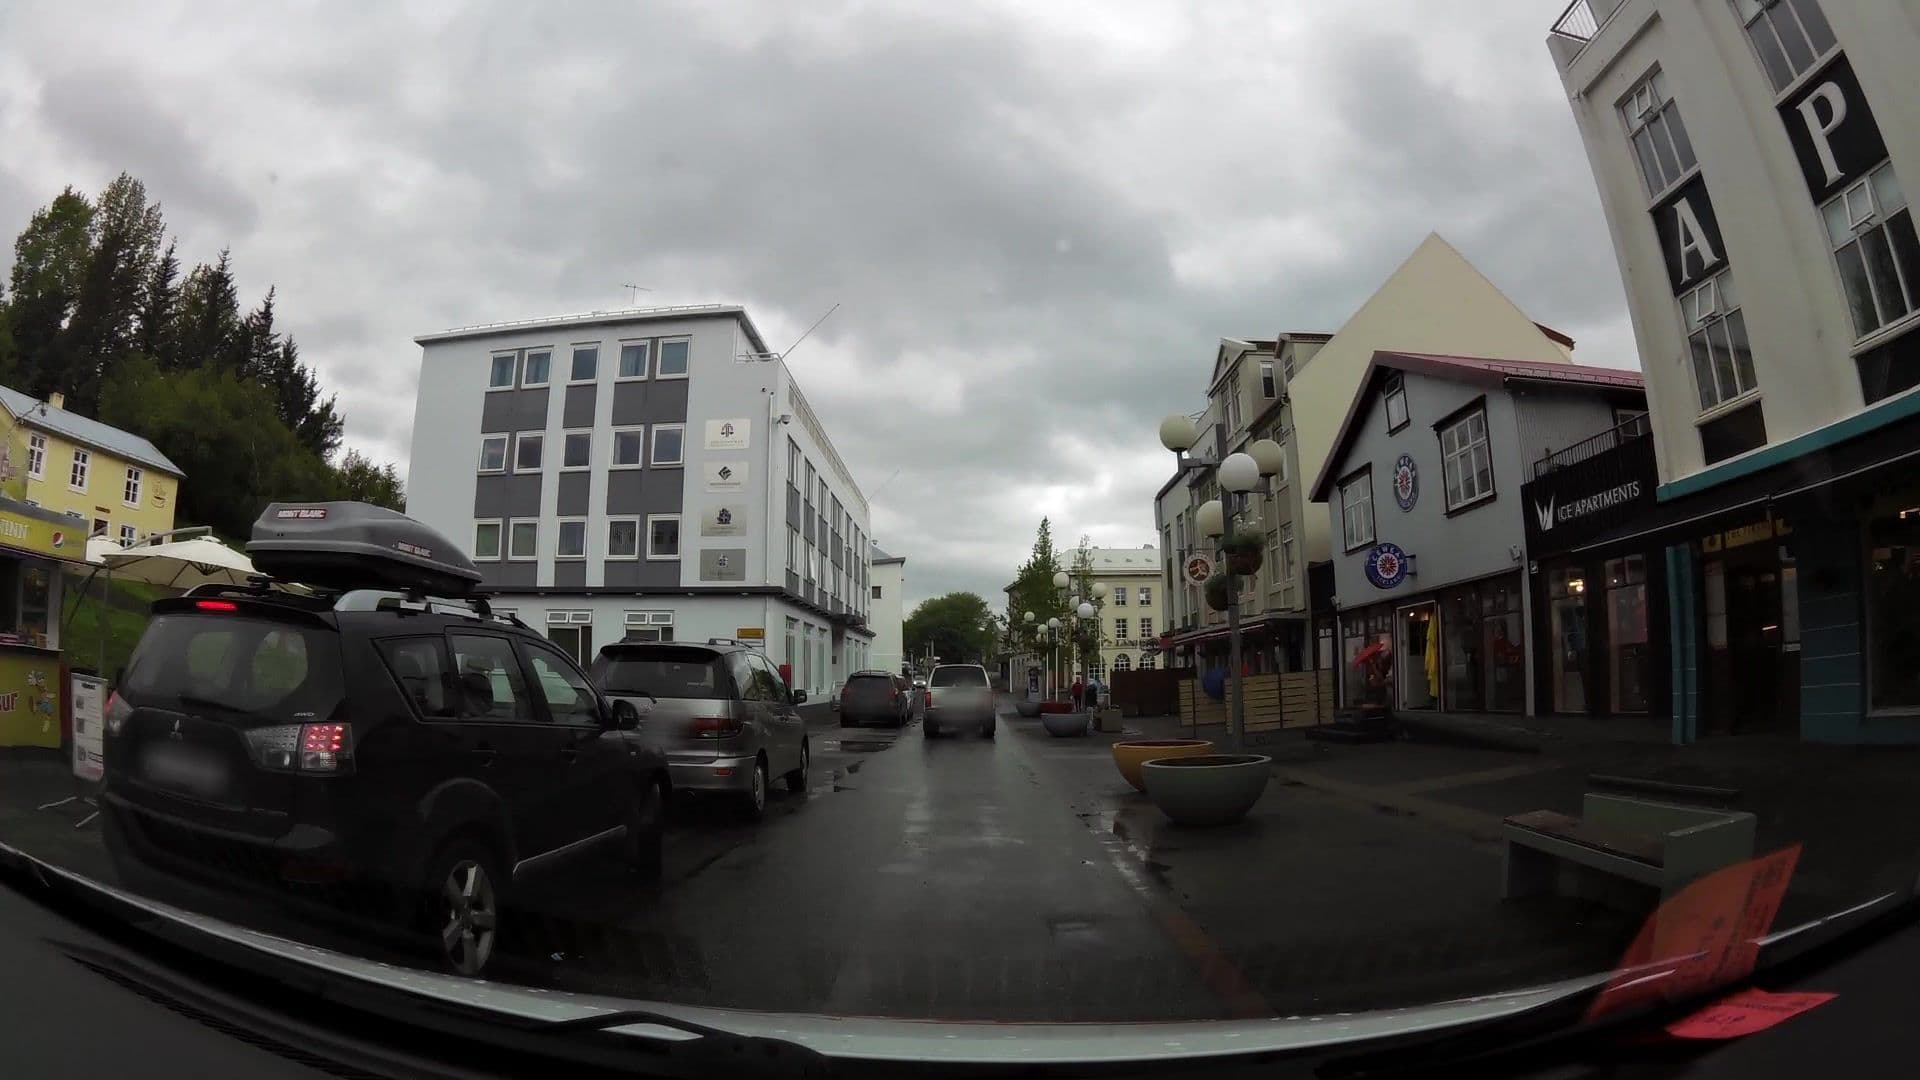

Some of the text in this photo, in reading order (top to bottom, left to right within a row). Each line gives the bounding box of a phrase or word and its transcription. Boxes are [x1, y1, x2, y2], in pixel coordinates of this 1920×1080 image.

[1557, 504, 1573, 521] ICE
[1574, 481, 1640, 516] APARTMENTS
[277, 509, 325, 519] MONT BLANC
[1370, 545, 1404, 566] ICEWEAR
